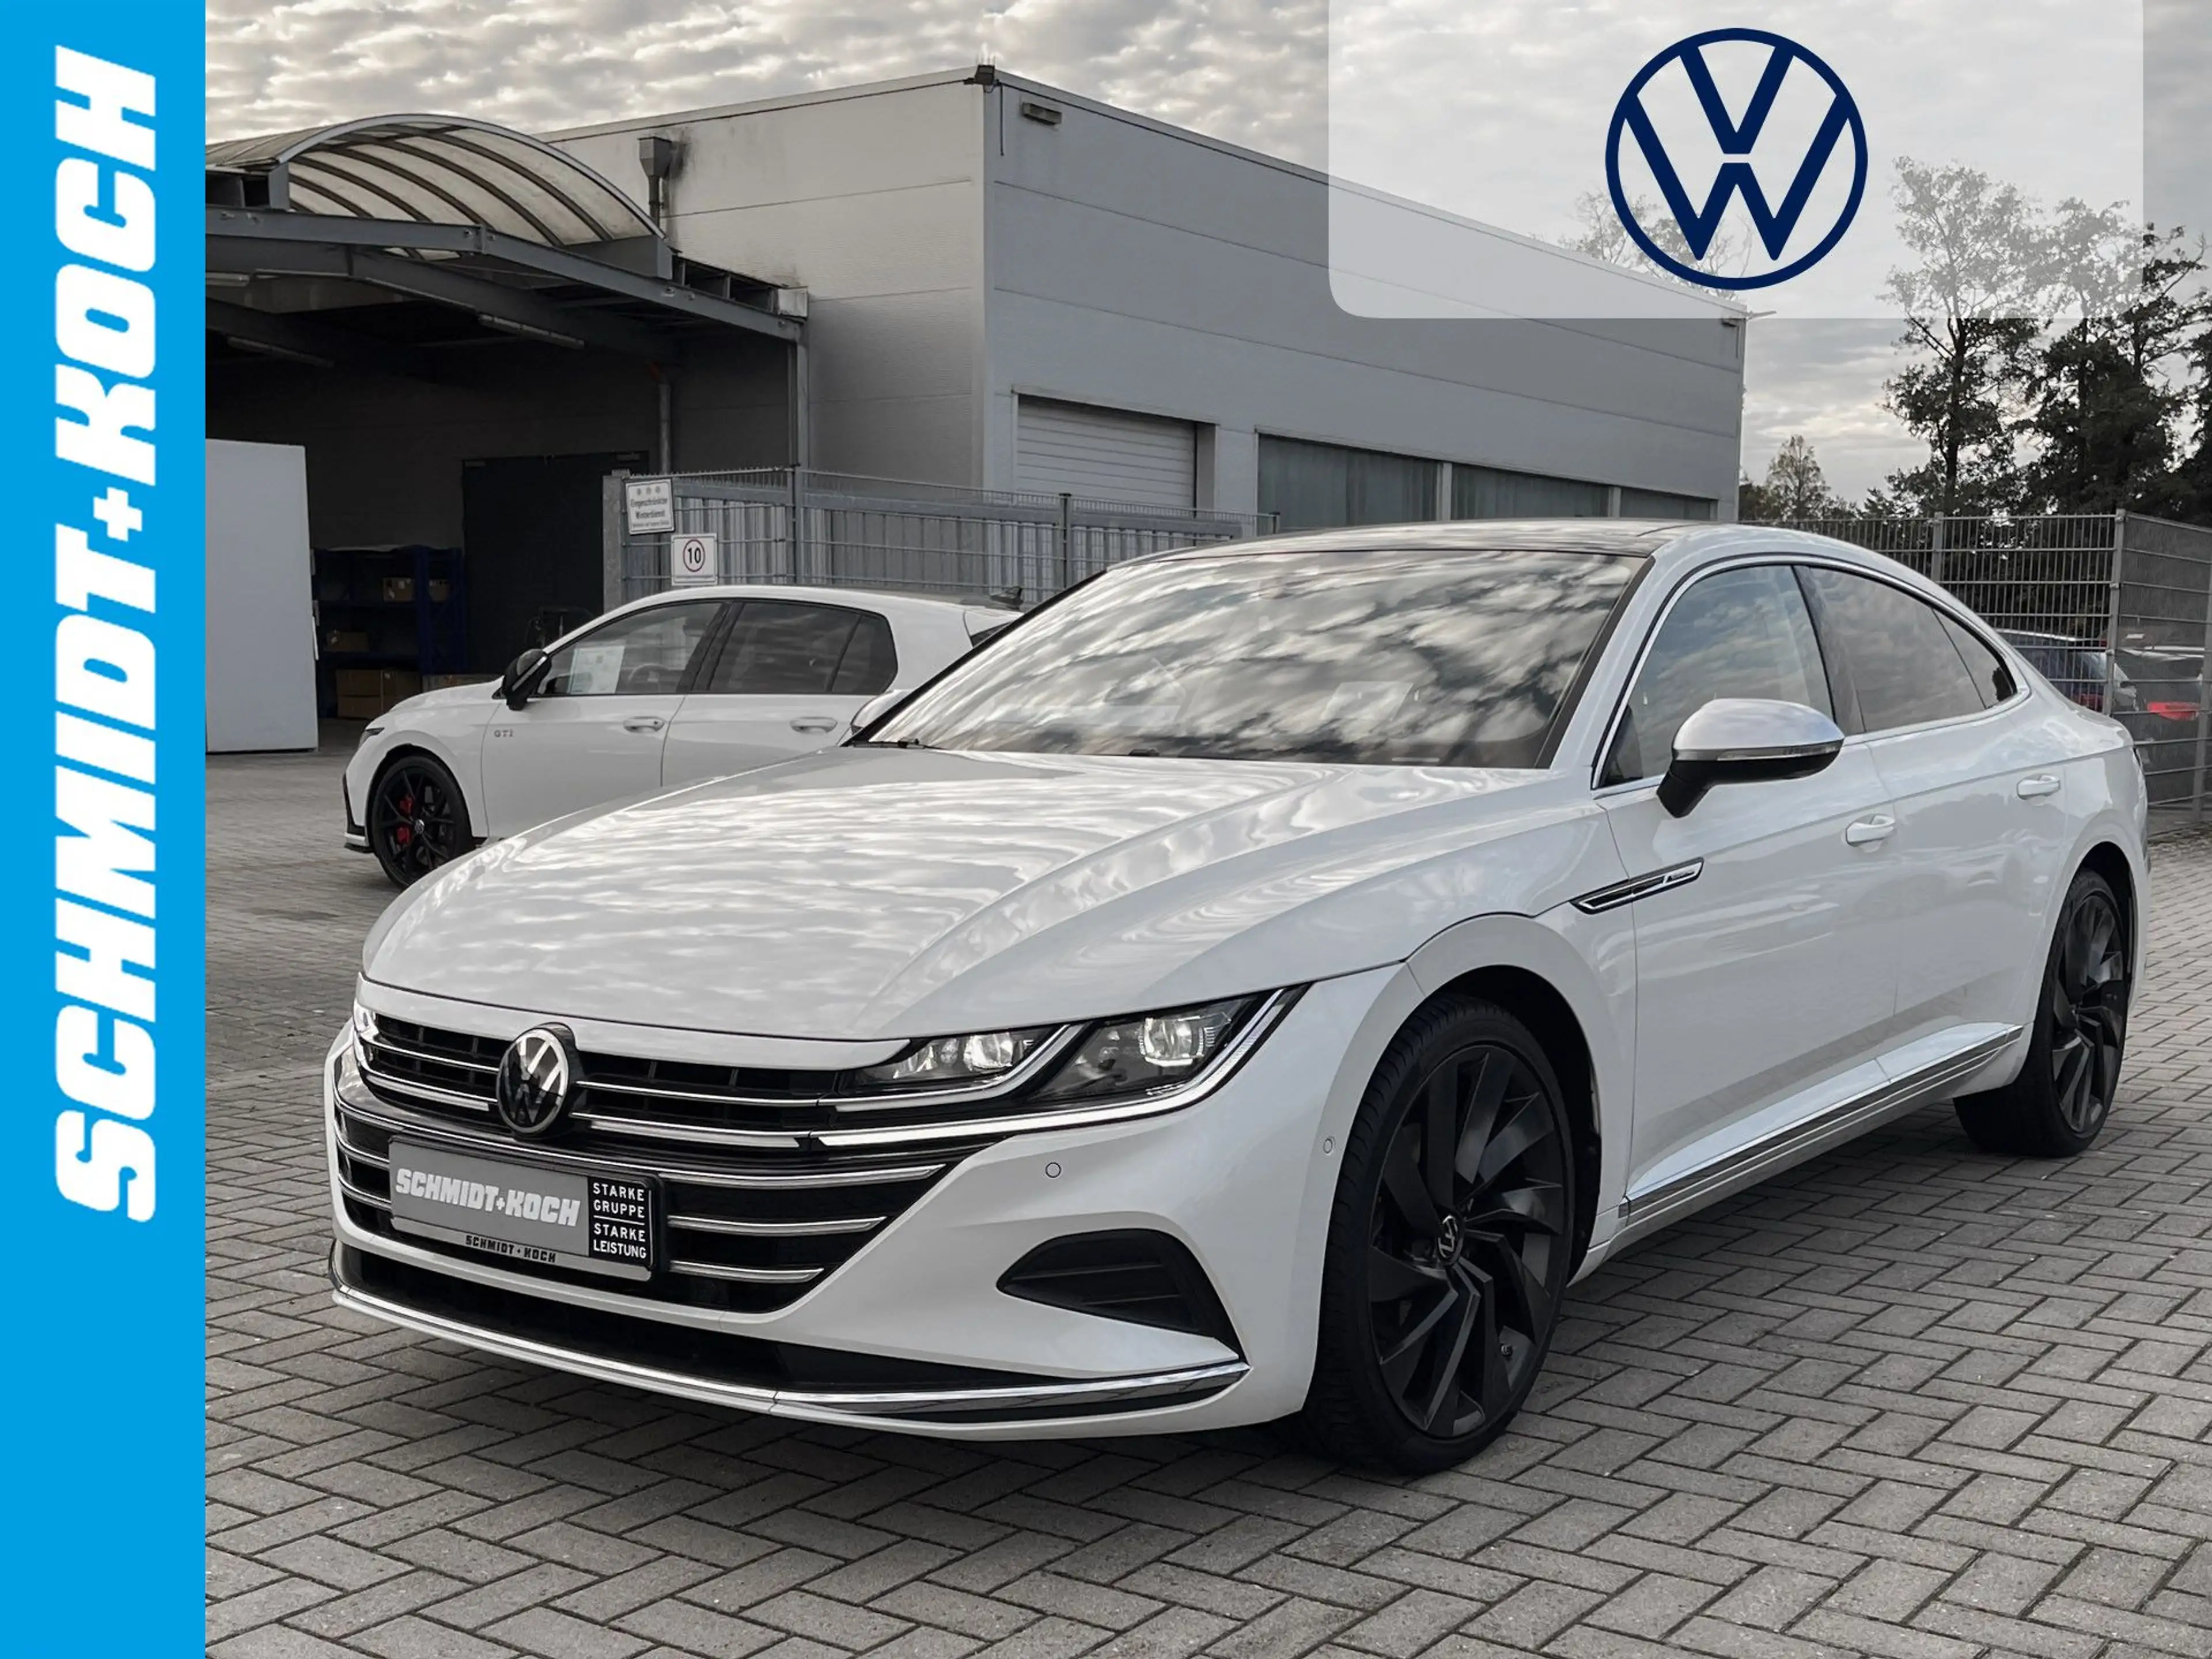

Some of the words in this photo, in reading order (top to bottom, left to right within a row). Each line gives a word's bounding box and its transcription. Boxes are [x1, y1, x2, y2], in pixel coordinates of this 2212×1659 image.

[688, 547, 701, 564] 10
[395, 1168, 581, 1227] SCHMIDT+KOCH
[593, 1183, 645, 1202] STARKE
[593, 1199, 645, 1219] GRUPPE
[593, 1222, 646, 1242] STARKE
[465, 1235, 515, 1255] SCHMIDT
[524, 1247, 556, 1263] KOCH
[593, 1239, 646, 1259] LEISTUNG
